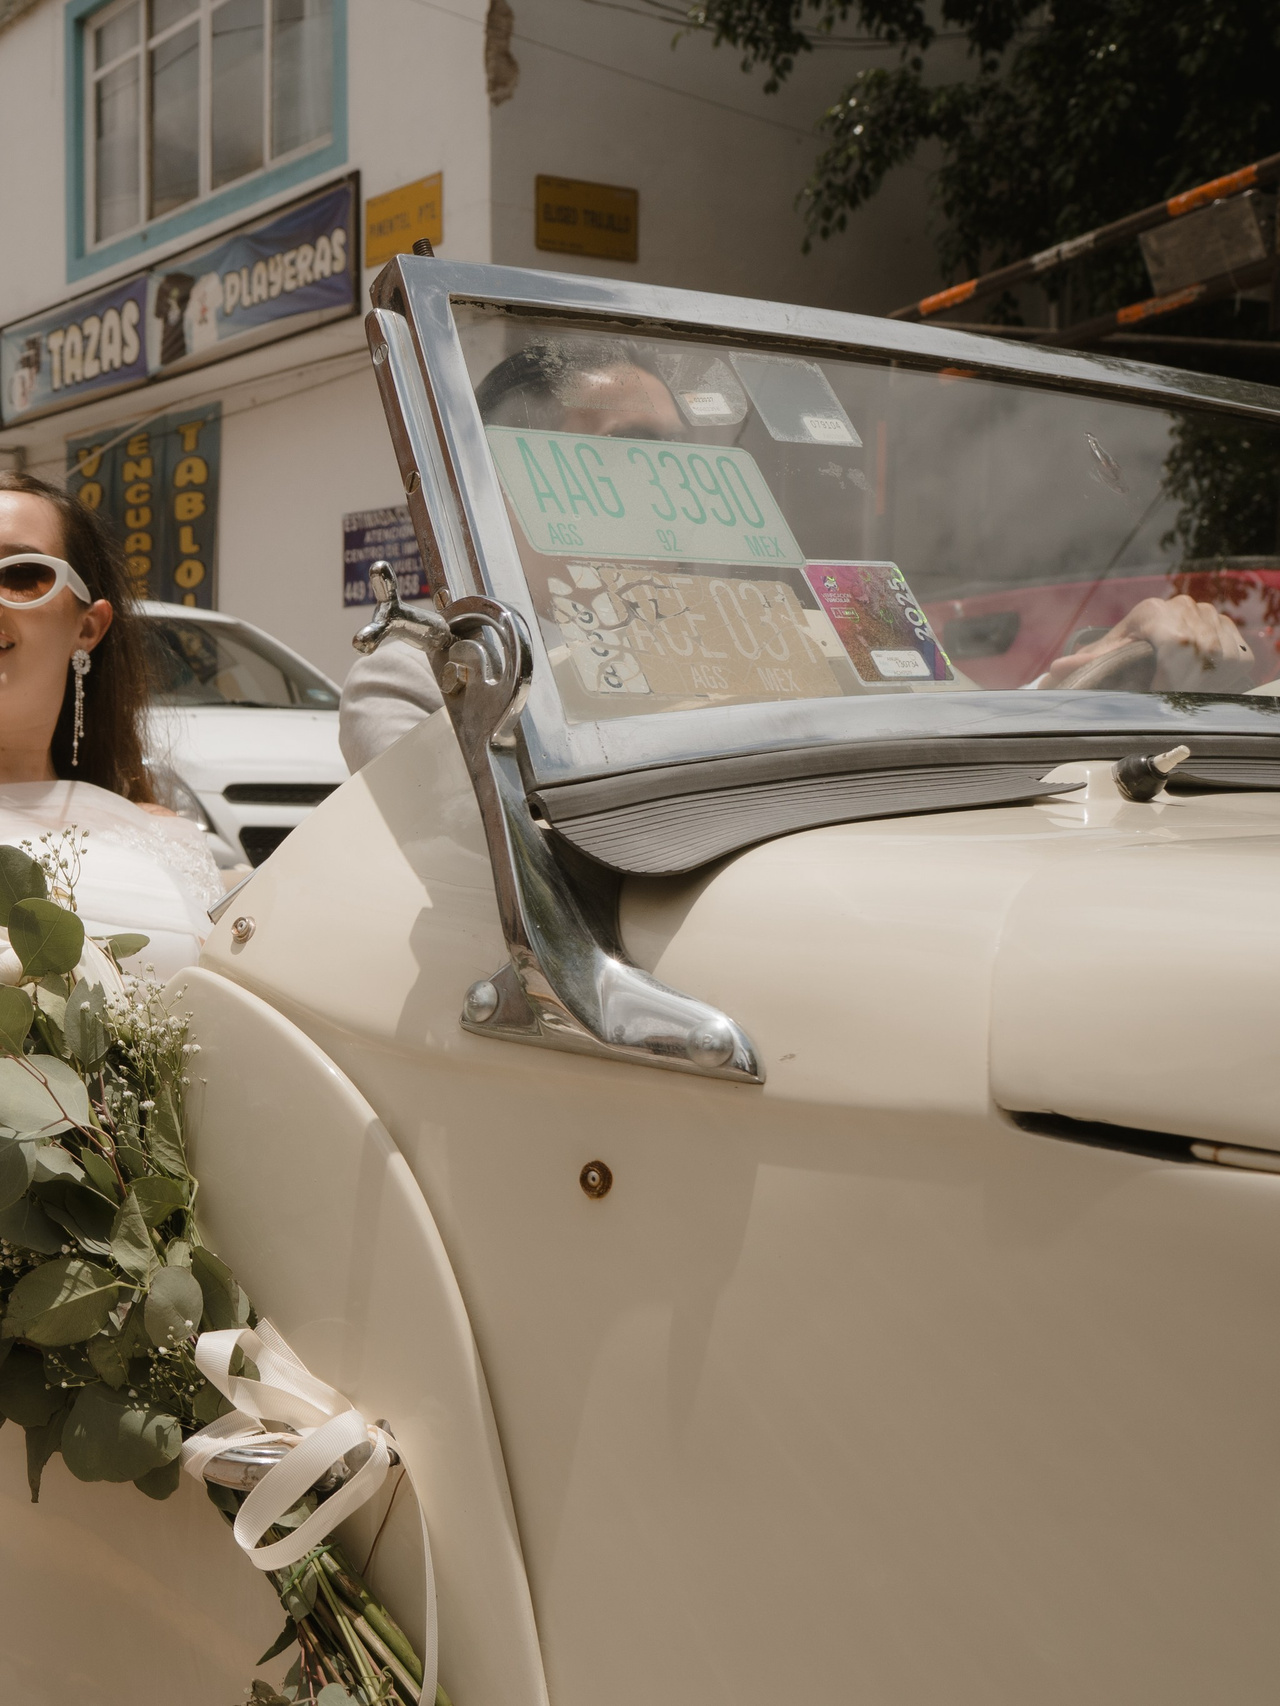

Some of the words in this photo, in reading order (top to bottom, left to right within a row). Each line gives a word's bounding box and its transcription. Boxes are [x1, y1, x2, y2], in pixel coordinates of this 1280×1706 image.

[223, 228, 347, 317] PLAYERAS
[47, 299, 141, 391] TAZAS
[810, 420, 841, 430] 079104
[516, 436, 626, 519] AAG
[626, 446, 766, 529] 3390
[344, 545, 385, 564] CENTRO
[547, 522, 584, 546] AGS
[655, 529, 683, 552] 92
[743, 535, 786, 558] MEX
[344, 580, 366, 601] 449
[887, 577, 931, 641] 2025
[690, 664, 729, 690] AGS
[756, 667, 802, 692] MEX
